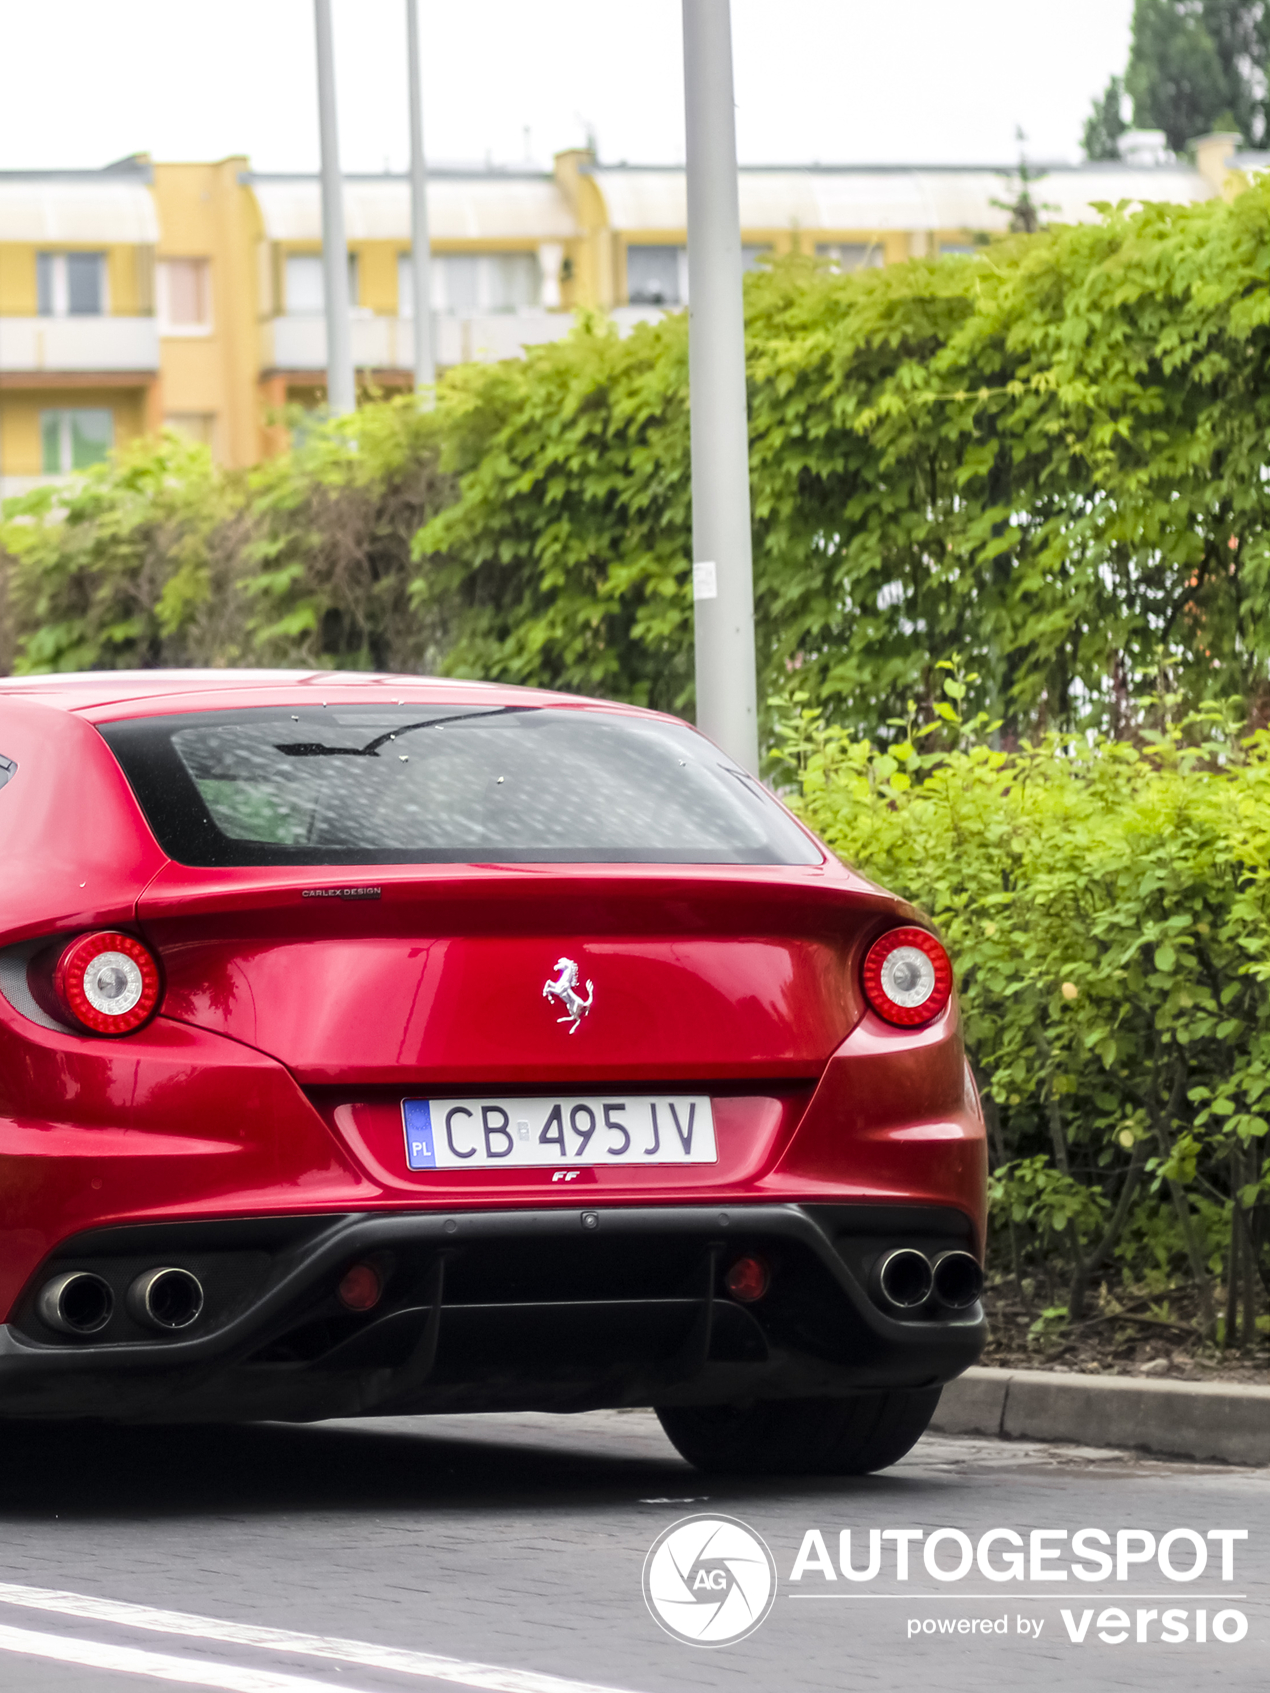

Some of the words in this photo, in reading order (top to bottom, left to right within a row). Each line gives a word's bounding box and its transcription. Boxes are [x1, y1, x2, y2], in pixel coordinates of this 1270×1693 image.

[302, 889, 342, 897] CARLEX
[343, 887, 381, 896] DESIGN
[445, 1105, 514, 1159] CB
[538, 1103, 697, 1157] 495JV
[412, 1141, 431, 1156] PL
[551, 1171, 580, 1182] FF
